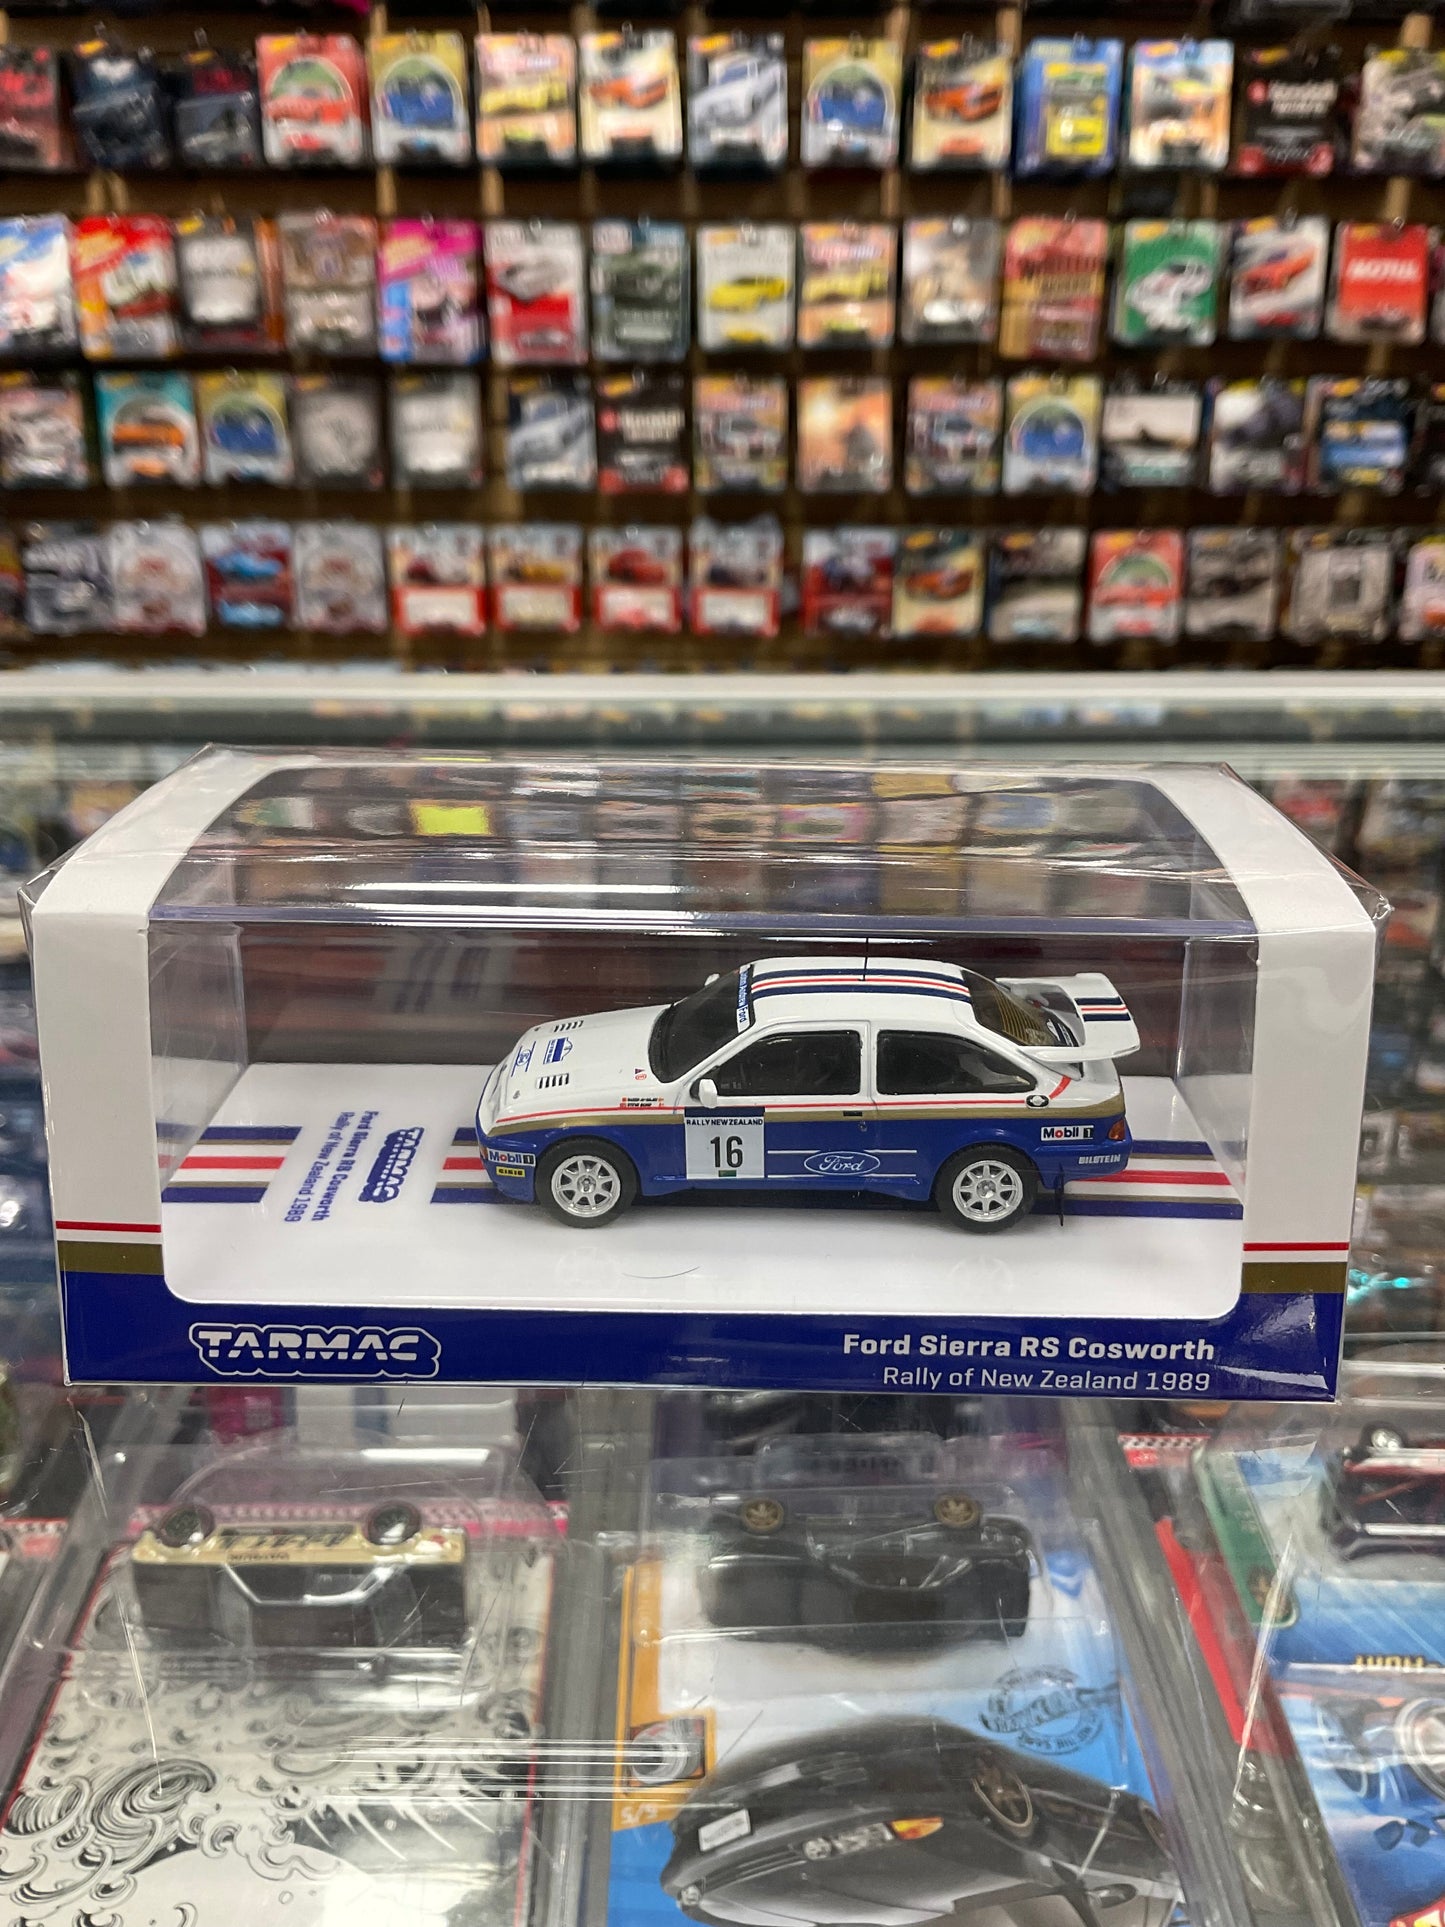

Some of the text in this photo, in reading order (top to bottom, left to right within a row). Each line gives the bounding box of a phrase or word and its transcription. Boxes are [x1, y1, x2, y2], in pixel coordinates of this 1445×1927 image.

[686, 1117, 763, 1126] RALLY NEW ZEALAND
[1043, 1126, 1080, 1139] Mobil
[373, 1128, 421, 1198] TARMAC
[489, 1151, 522, 1163] Mobil
[711, 1135, 744, 1168] 16
[818, 1150, 865, 1172] Ford
[299, 1161, 329, 1195] Zealand
[284, 1197, 310, 1222] 1989
[197, 1330, 420, 1362] TARMAC
[843, 1333, 1214, 1360] Ford Sierra RS Cosworth
[883, 1366, 1211, 1392] Rally of New Zealand 1989
